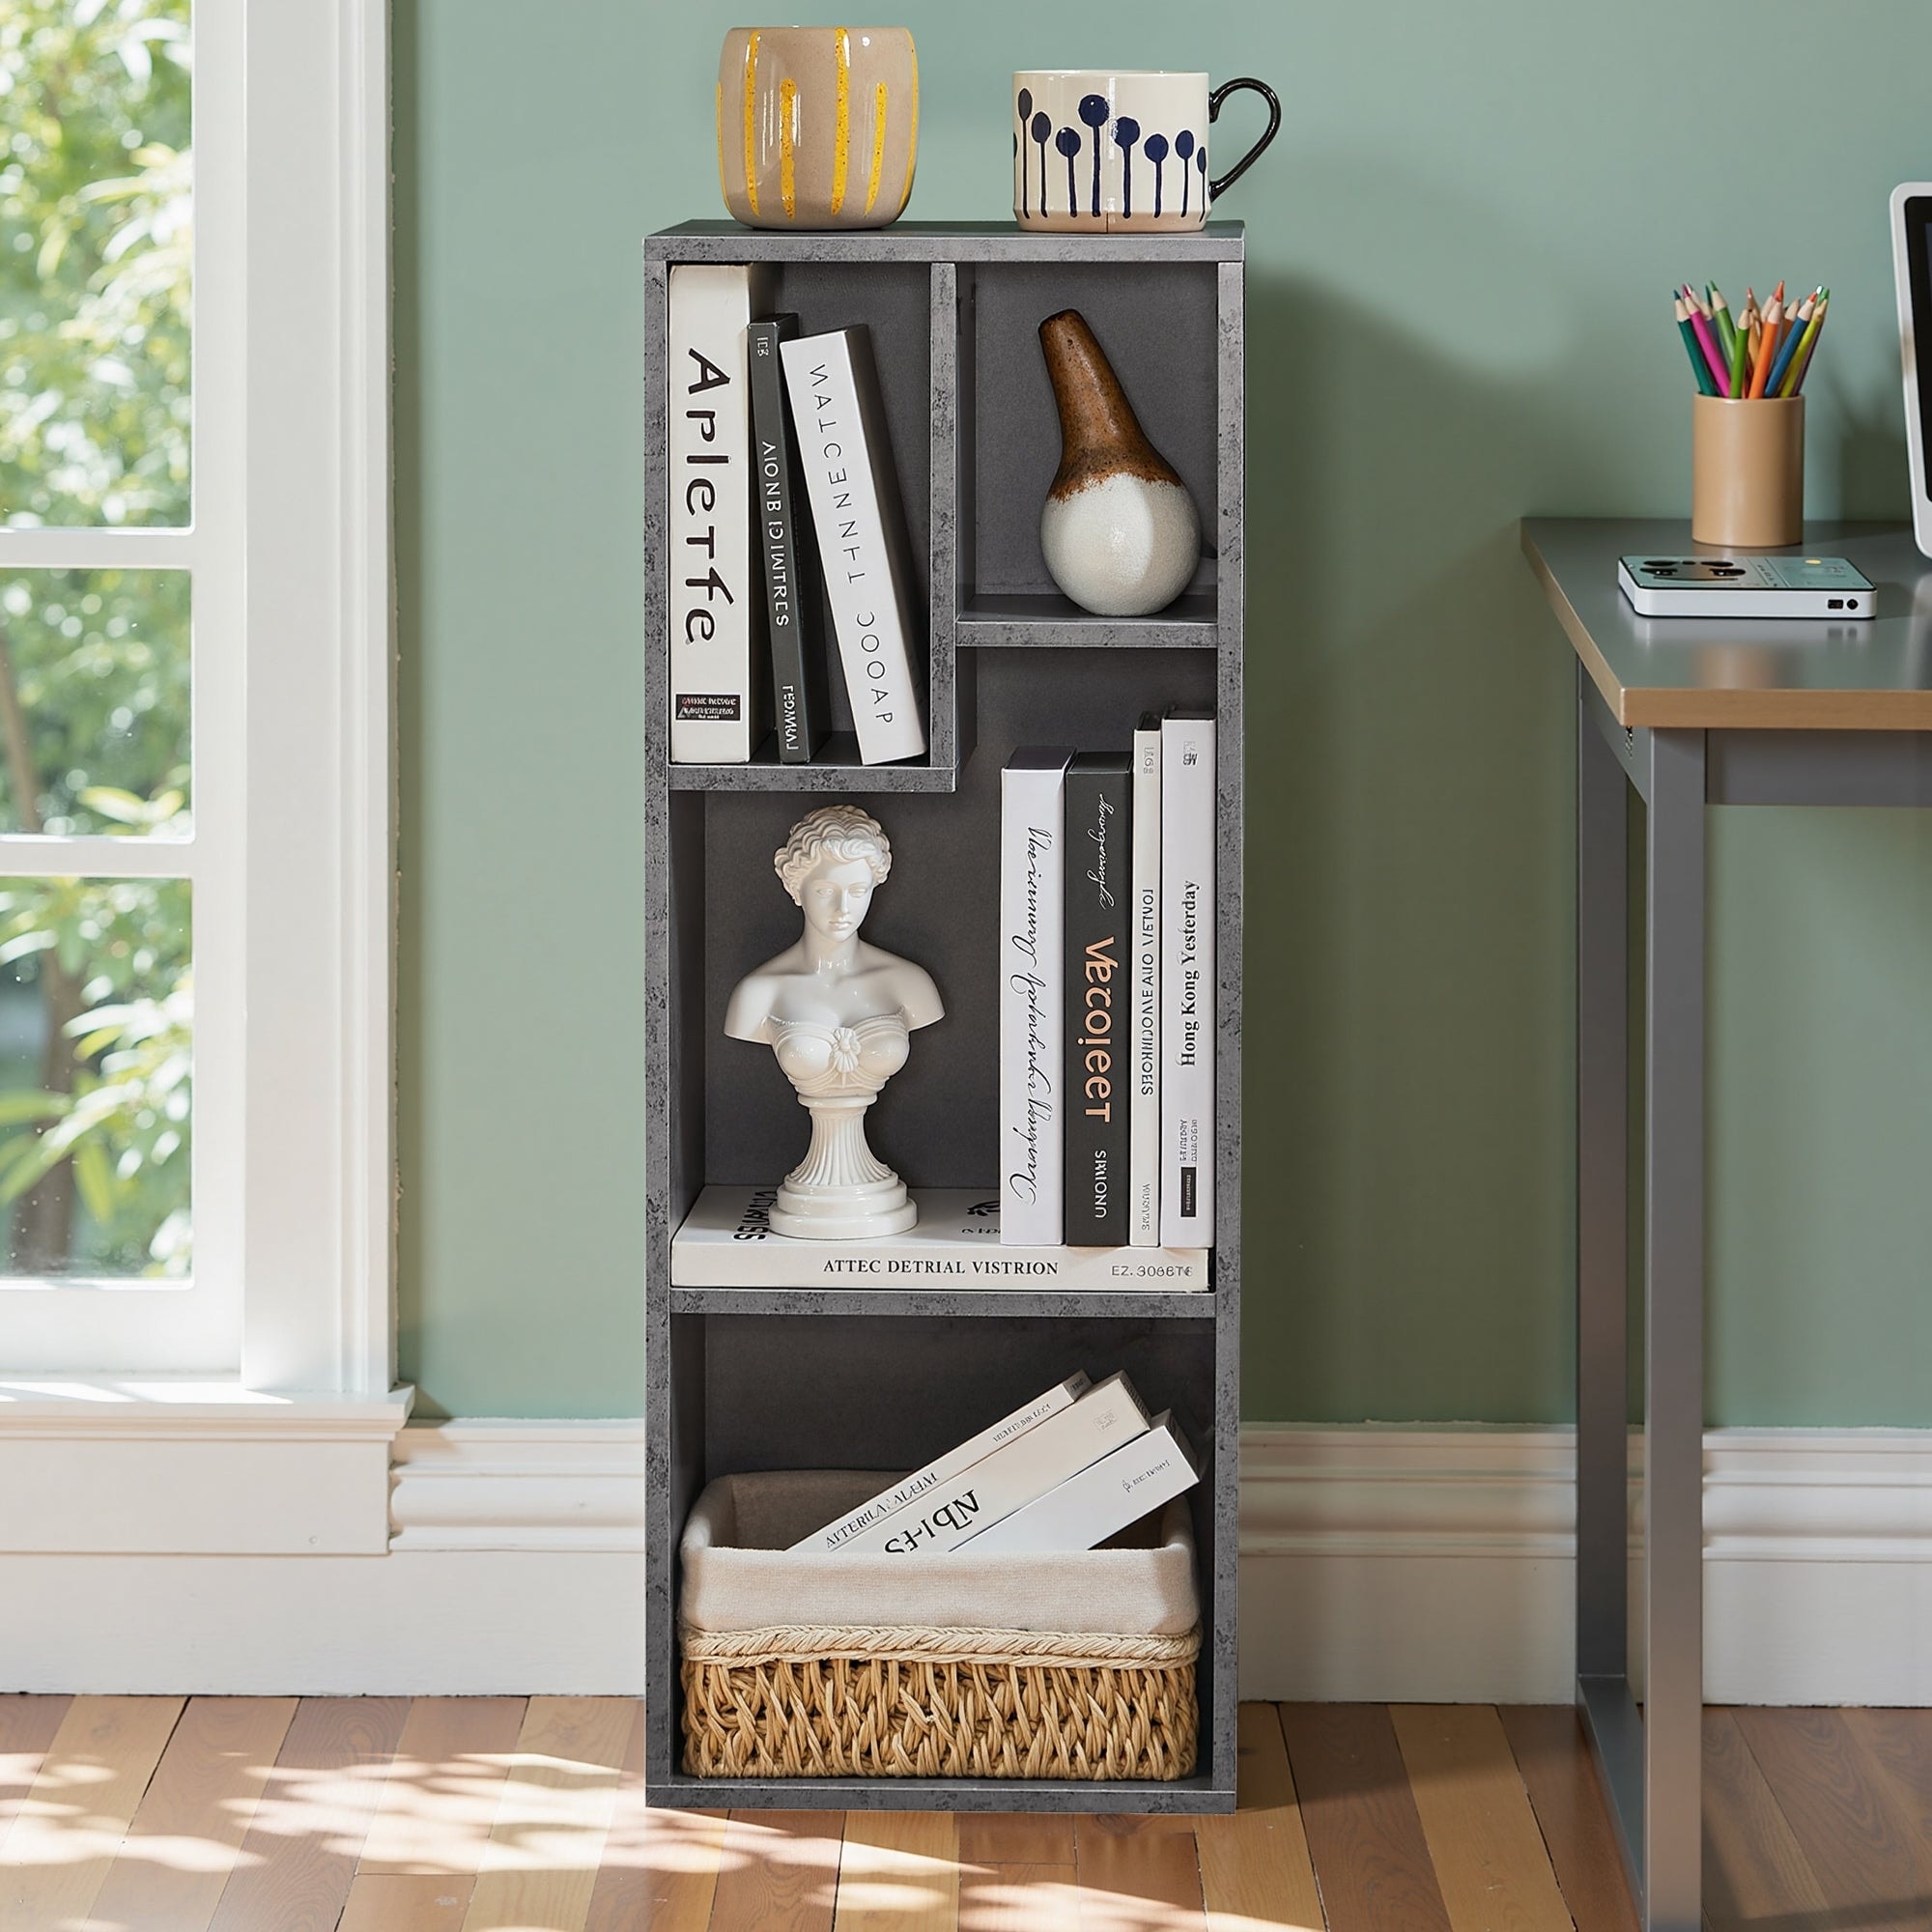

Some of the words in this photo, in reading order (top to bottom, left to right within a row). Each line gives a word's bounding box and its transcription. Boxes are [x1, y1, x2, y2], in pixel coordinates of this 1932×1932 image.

[1179, 880, 1199, 966] Yesterday
[1179, 970, 1199, 1016] Kong
[1179, 1021, 1199, 1067] Hong
[823, 1260, 881, 1274] ATTEC
[887, 1260, 965, 1275] DETRIAL
[971, 1261, 1059, 1276] VISTRION
